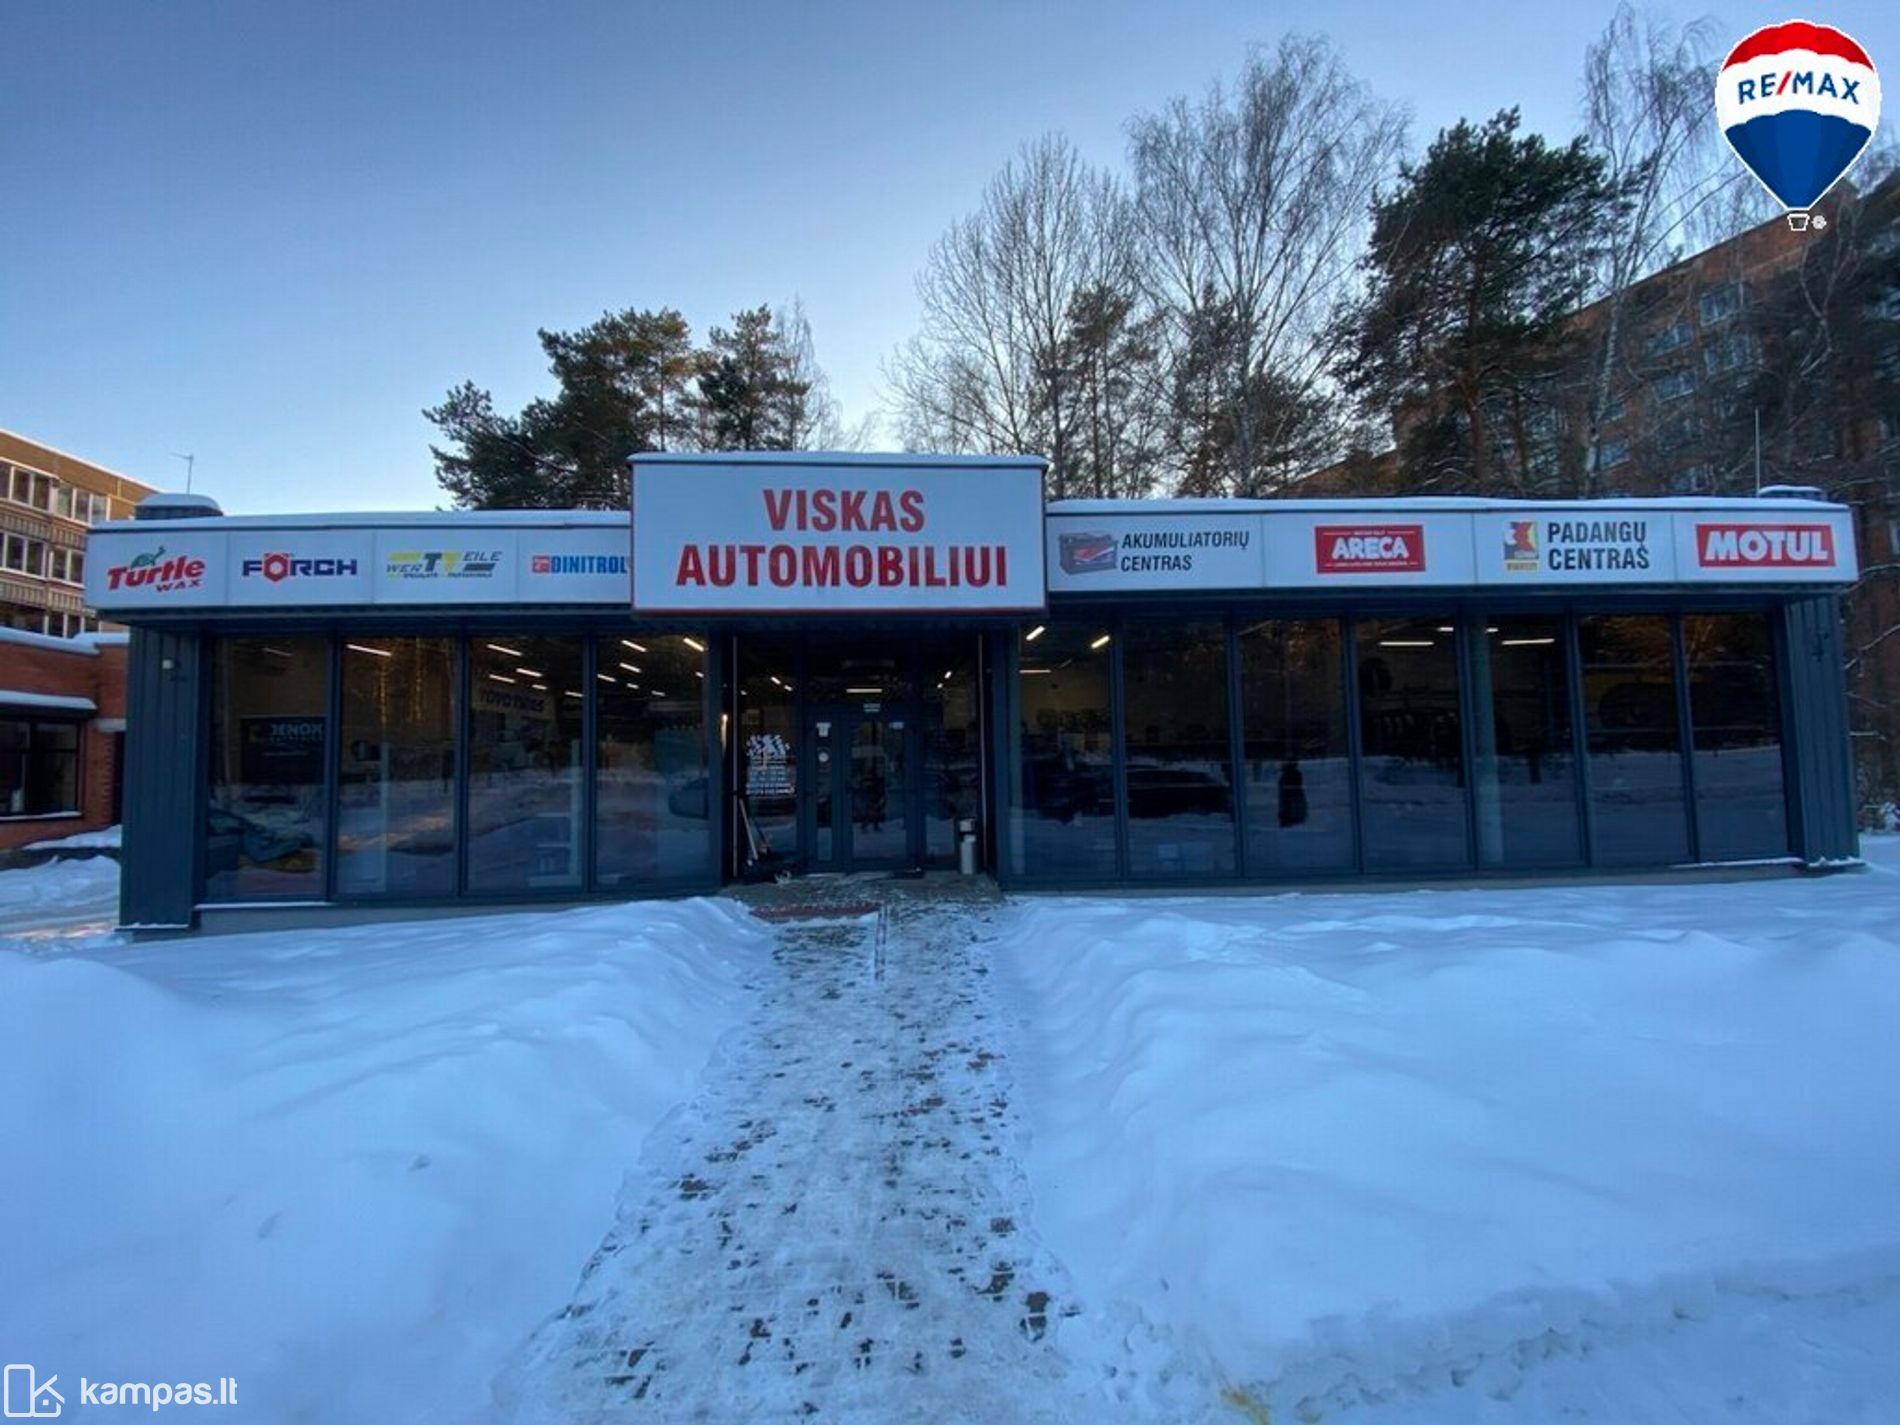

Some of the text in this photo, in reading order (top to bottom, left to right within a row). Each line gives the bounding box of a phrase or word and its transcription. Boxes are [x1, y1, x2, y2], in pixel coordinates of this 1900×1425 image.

[763, 489, 925, 532] VISKAS
[1121, 530, 1250, 551] AKUMULIATORIŲ
[1547, 521, 1647, 547] PADANGŲ
[1704, 529, 1828, 561] MOTUL
[1331, 536, 1409, 560] ARECA
[1549, 547, 1650, 570] CENTRAS
[107, 554, 206, 590] Turtle
[551, 556, 628, 574] DINITROL
[676, 544, 1007, 588] AUTOMOBILIUI
[1120, 555, 1192, 572] CENTRAS
[156, 579, 202, 592] WAX
